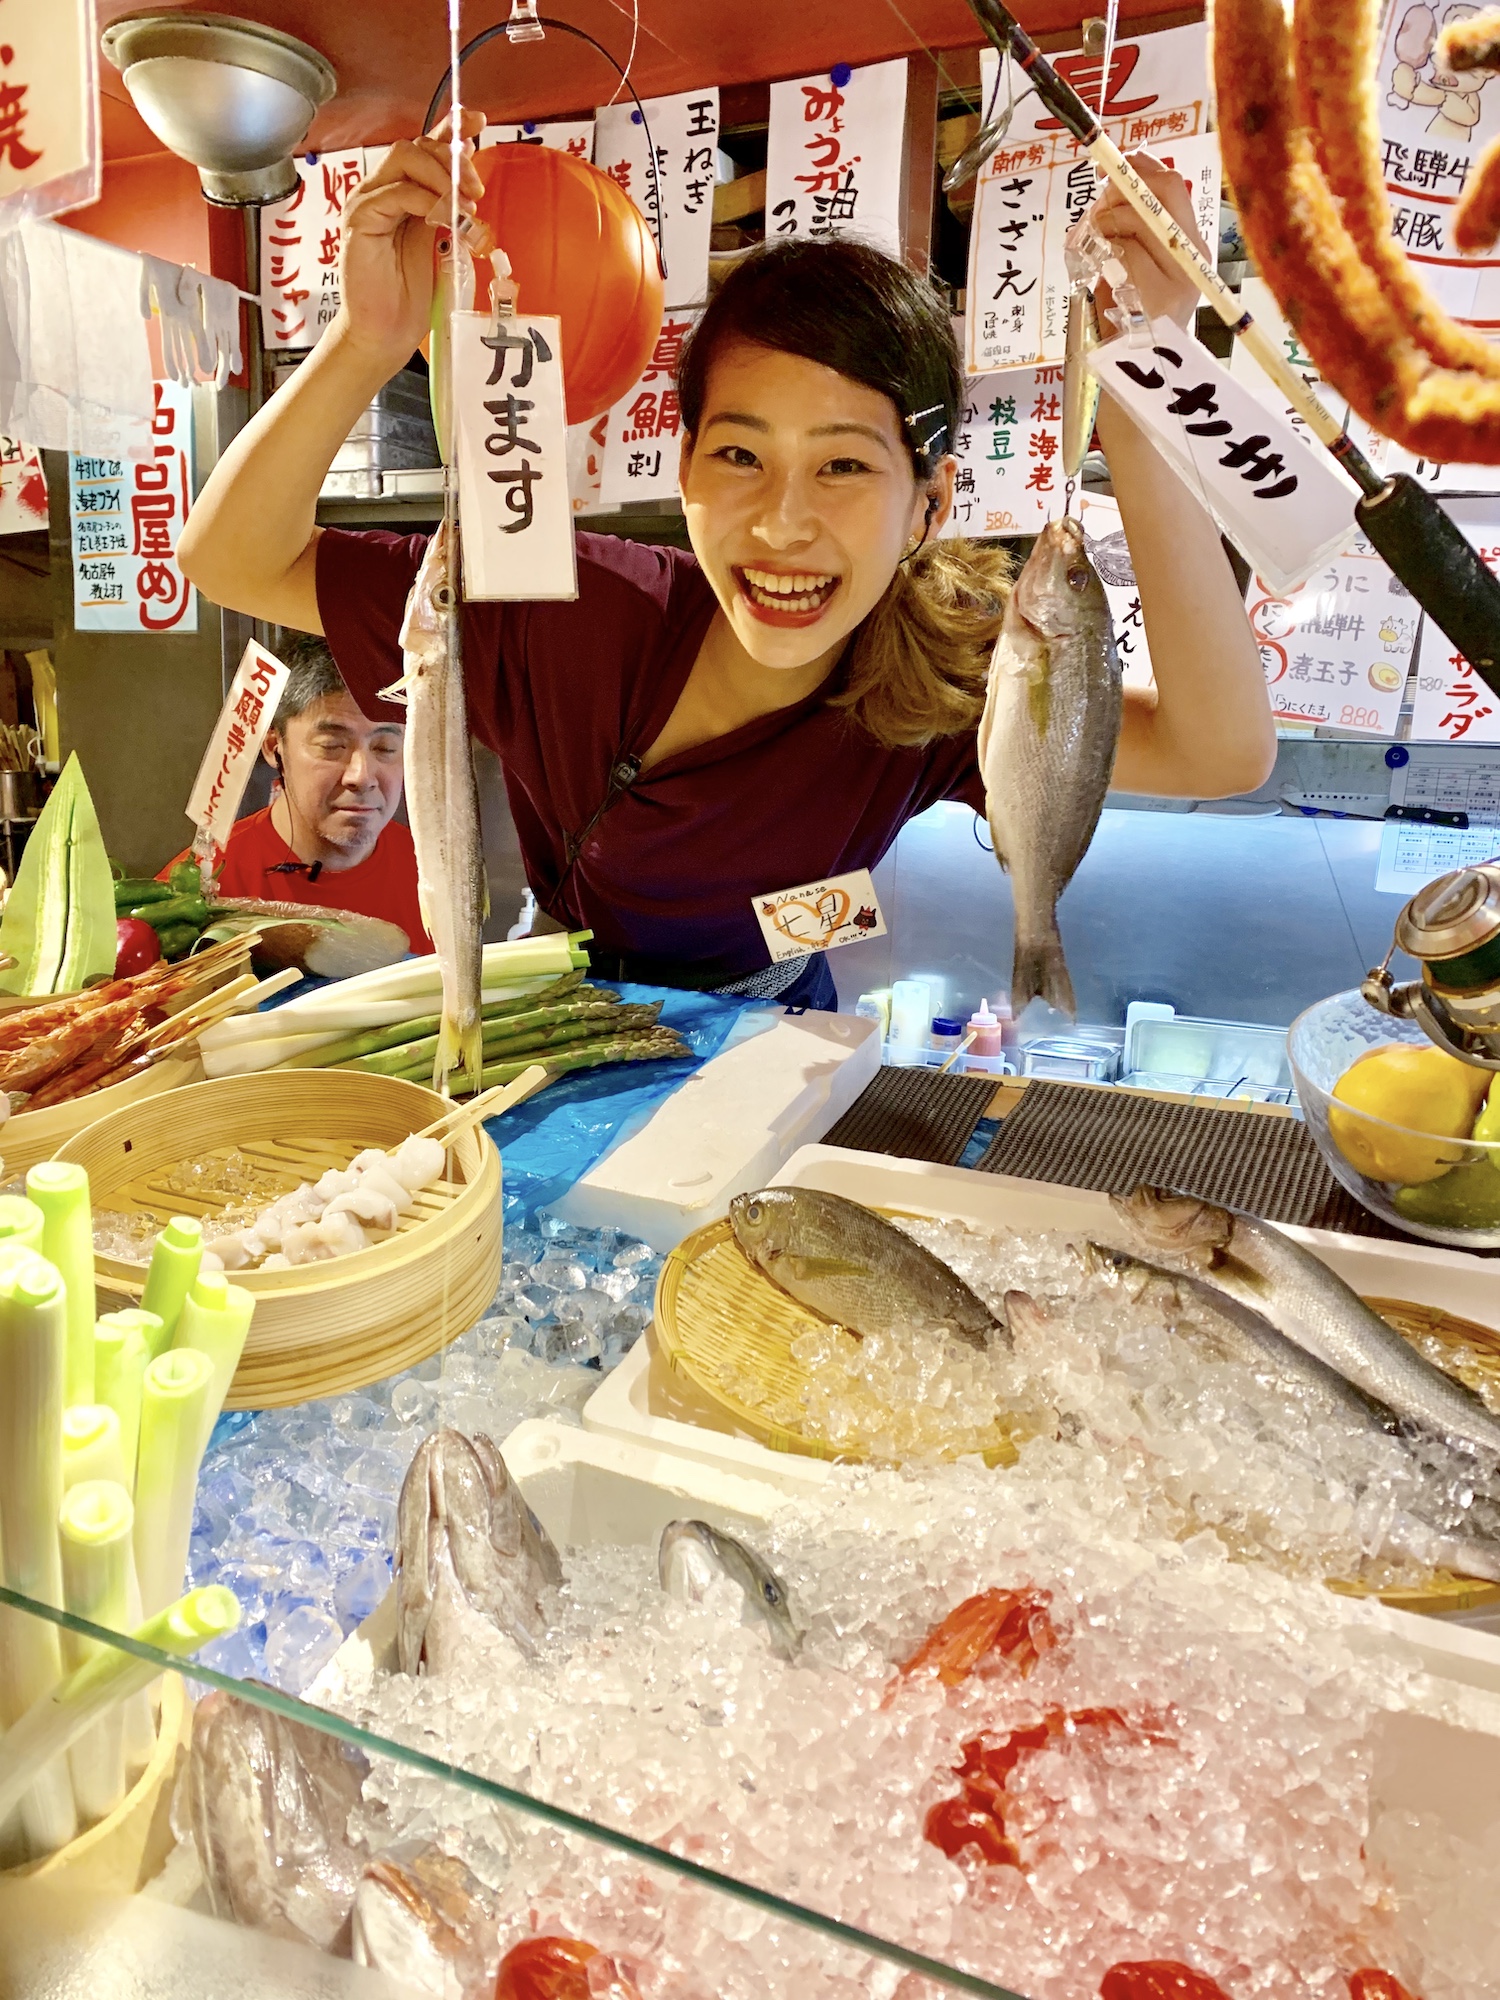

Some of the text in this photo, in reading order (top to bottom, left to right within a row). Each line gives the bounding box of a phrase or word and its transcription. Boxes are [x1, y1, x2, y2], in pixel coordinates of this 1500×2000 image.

[683, 100, 717, 214] 玉ねぎ
[991, 144, 1046, 176] 南伊勢
[1129, 109, 1189, 142] 南伊勢
[268, 180, 310, 341] ニシャン
[992, 177, 1045, 301] さざえ
[480, 323, 553, 534] かます
[985, 396, 1018, 477] 枝豆の
[1115, 346, 1298, 499] いさき
[1324, 567, 1370, 593] うに
[1288, 652, 1360, 686] 煮玉子
[1438, 652, 1493, 740] サラダ
[774, 892, 852, 938] 七星
[776, 885, 828, 905] Nanase
